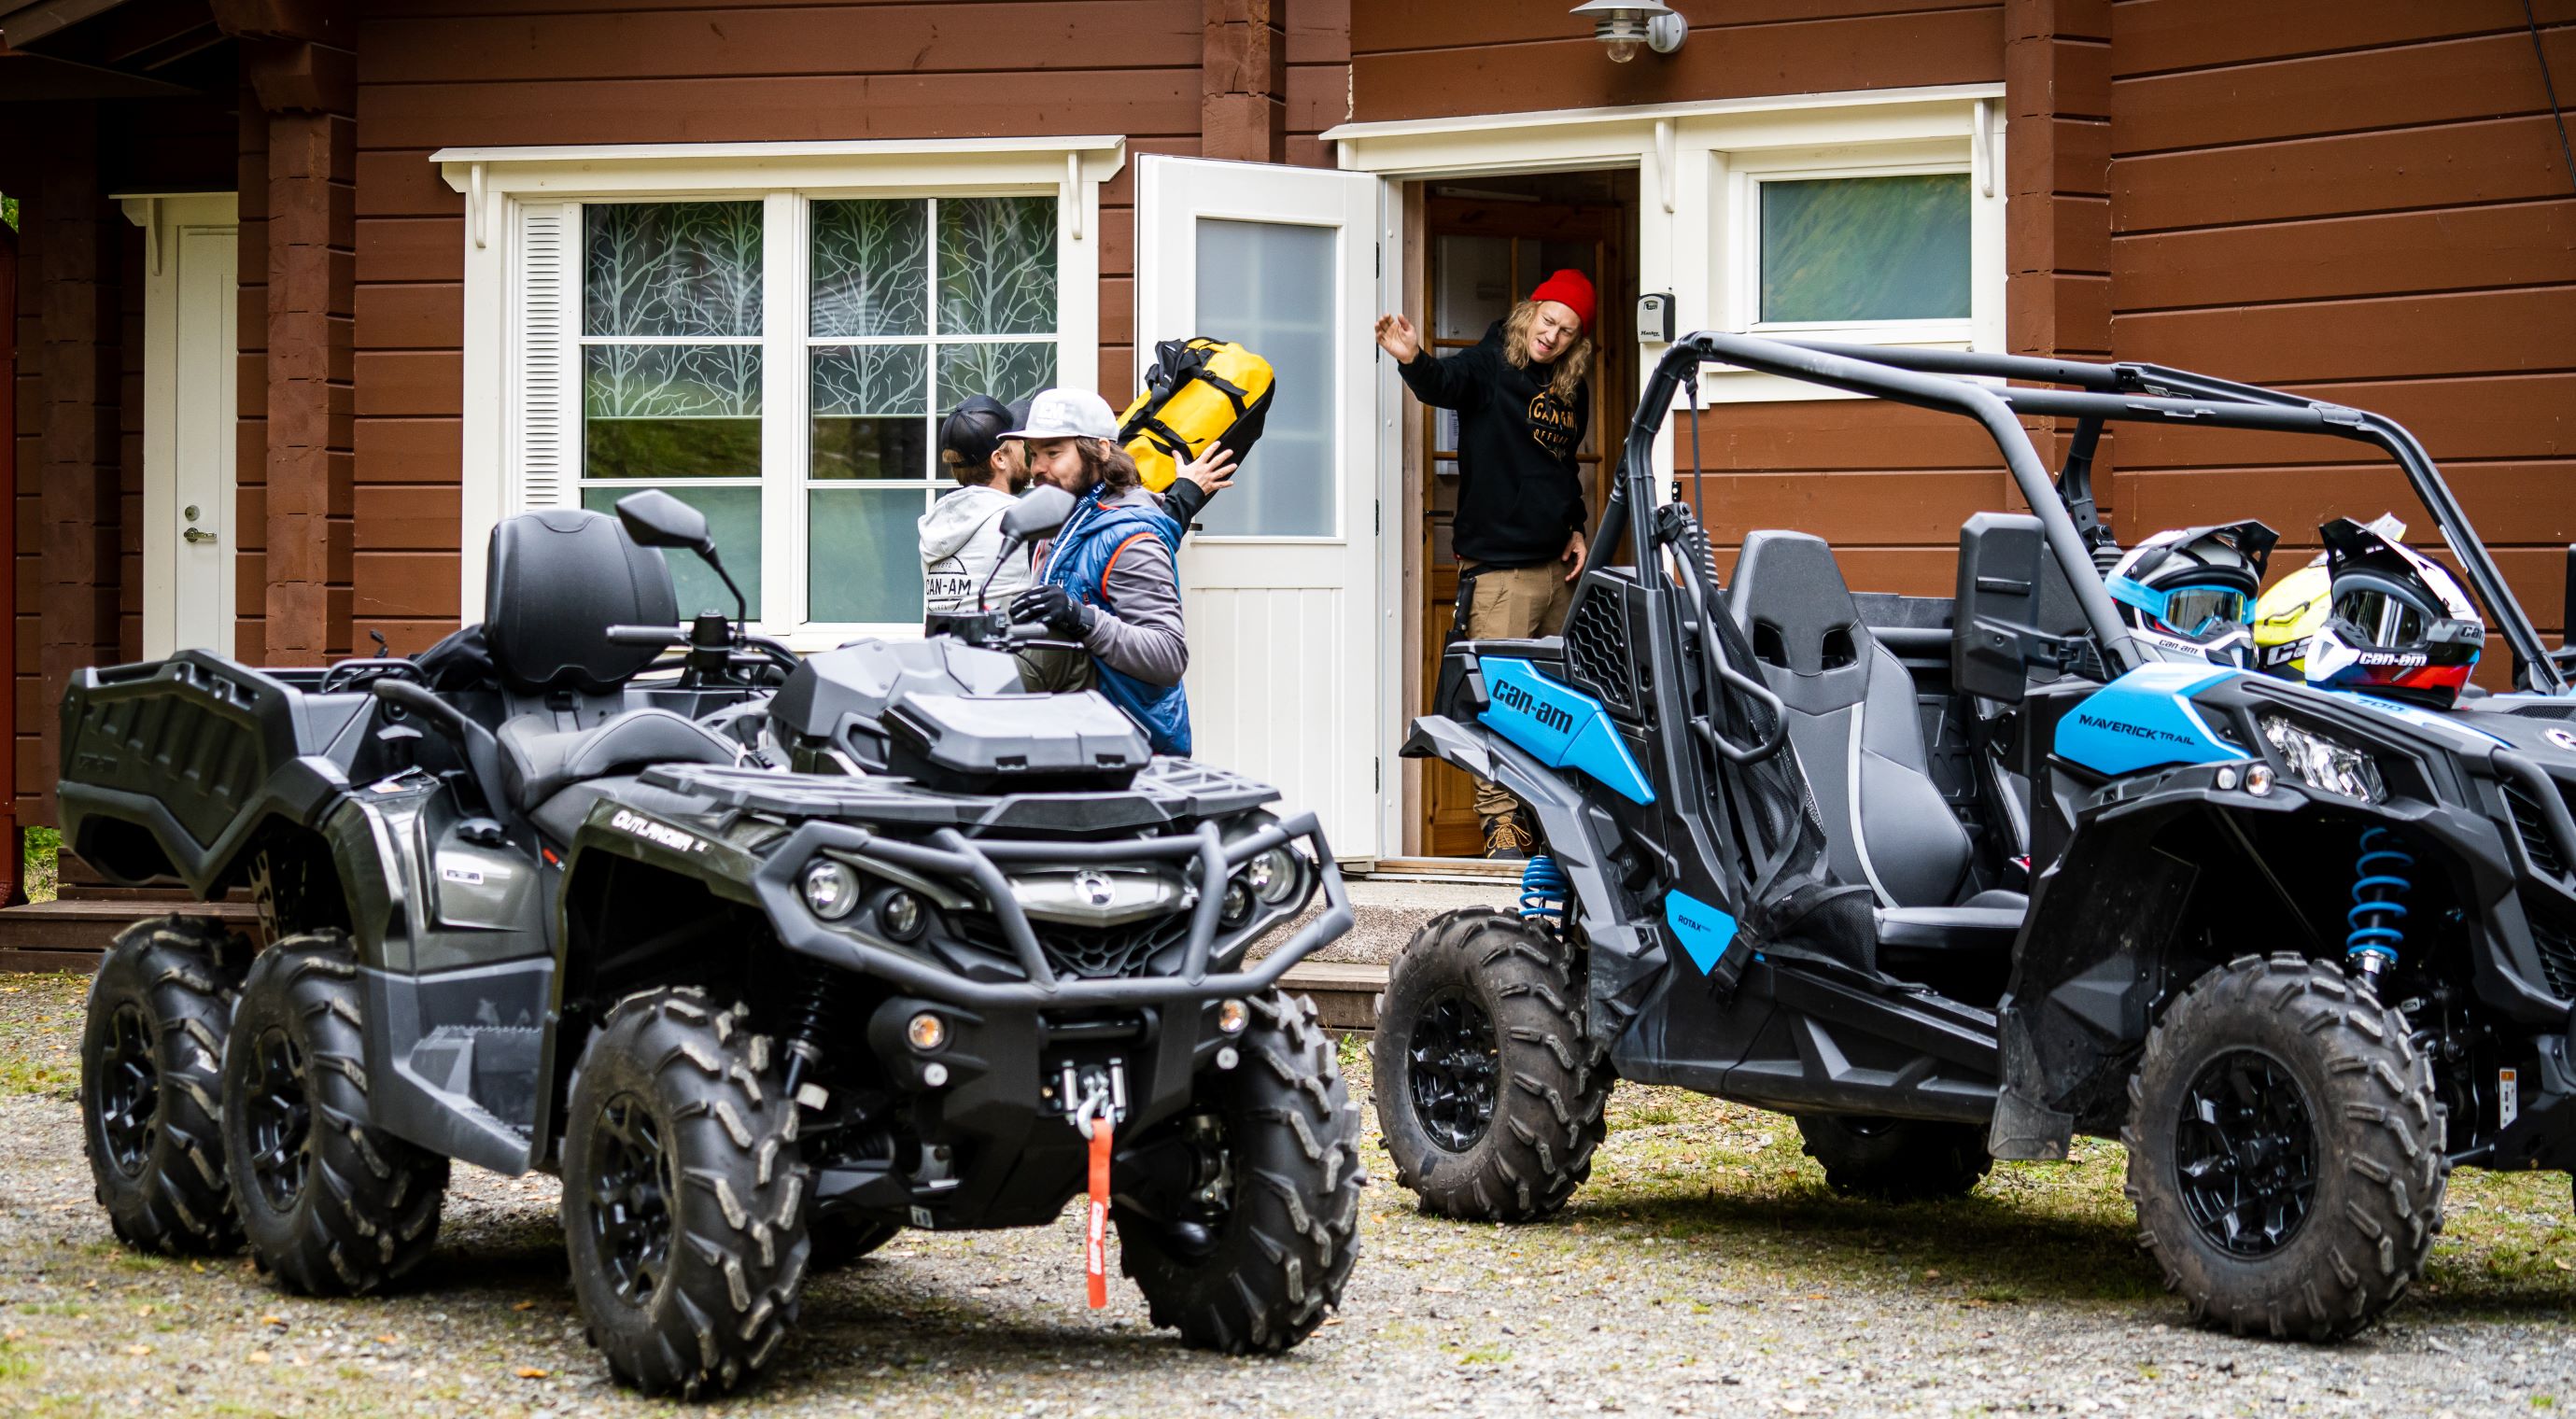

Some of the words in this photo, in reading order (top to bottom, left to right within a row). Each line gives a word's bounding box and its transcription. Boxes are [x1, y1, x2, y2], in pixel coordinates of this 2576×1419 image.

[926, 579, 972, 596] CAN-AM
[2159, 639, 2199, 654] can-am
[2358, 652, 2428, 667] can-am
[1492, 679, 1573, 735] can-am
[2078, 713, 2159, 740] MAVERICK
[2160, 731, 2195, 746] TRAIL
[612, 809, 695, 852] OUTLANDER
[1678, 914, 1702, 933] ROTAX
